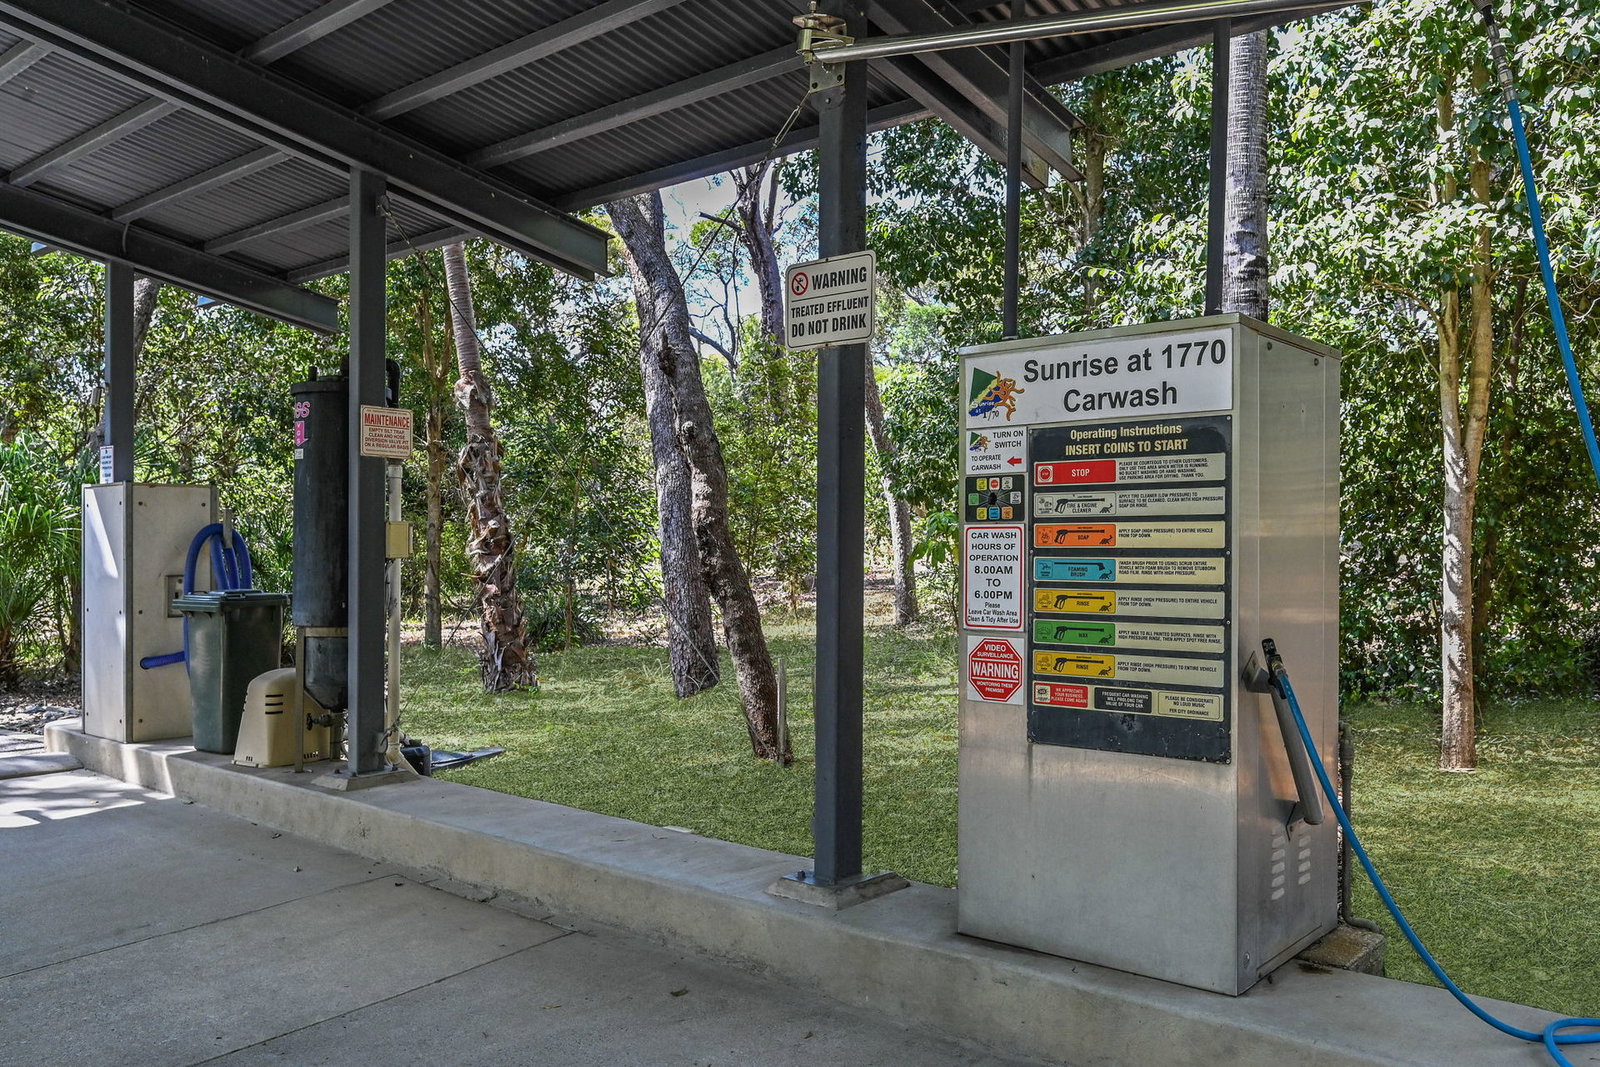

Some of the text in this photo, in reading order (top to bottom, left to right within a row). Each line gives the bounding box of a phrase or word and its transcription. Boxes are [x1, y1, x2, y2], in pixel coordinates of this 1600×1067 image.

[812, 267, 867, 290] WARNING
[791, 296, 869, 318] TREATED EFFLUENT
[792, 313, 867, 338] DO NOT DRINK
[1023, 339, 1226, 382] Sunrise at 1770
[1063, 381, 1178, 413] Carwash
[365, 413, 409, 428] MAINTENANCE
[1070, 424, 1182, 440] Operating Instructions
[1066, 439, 1188, 456] INSERT COINS TO START
[1071, 469, 1090, 477] STOP
[974, 566, 1013, 574] 8.00AM
[986, 578, 1001, 587] TO
[974, 590, 1012, 599] 6.00PM
[986, 616, 996, 624] Tidy
[984, 644, 1006, 652] VIDEO
[972, 662, 1019, 679] WARNING
